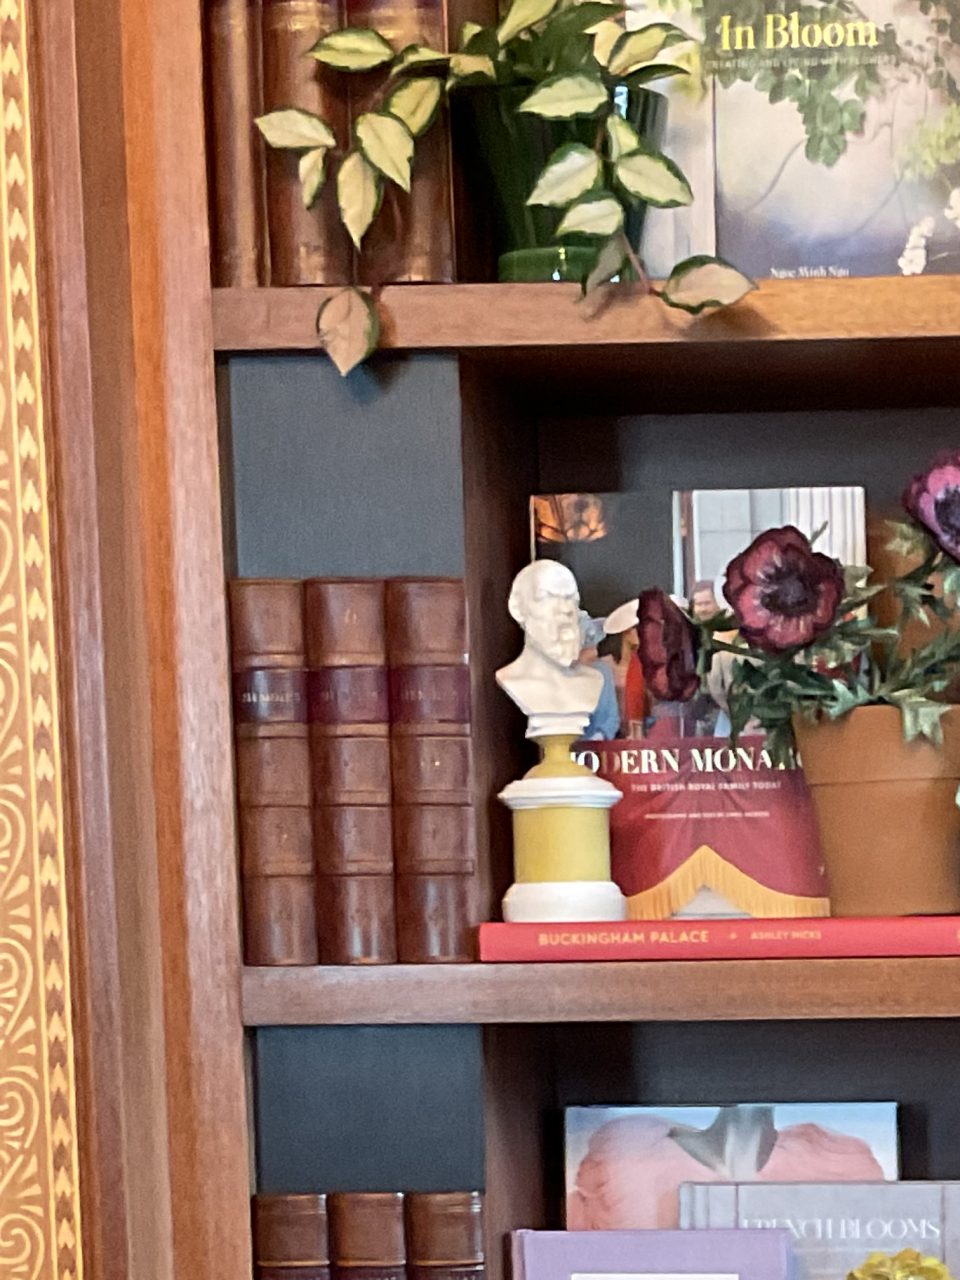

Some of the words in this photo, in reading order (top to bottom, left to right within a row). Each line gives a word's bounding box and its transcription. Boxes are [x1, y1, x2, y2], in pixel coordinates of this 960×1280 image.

[720, 14, 755, 50] In
[764, 11, 879, 50] Bloom
[538, 930, 645, 947] BUCKINGHAM
[649, 929, 709, 945] PALACE
[840, 1218, 941, 1240] BLOOMS
